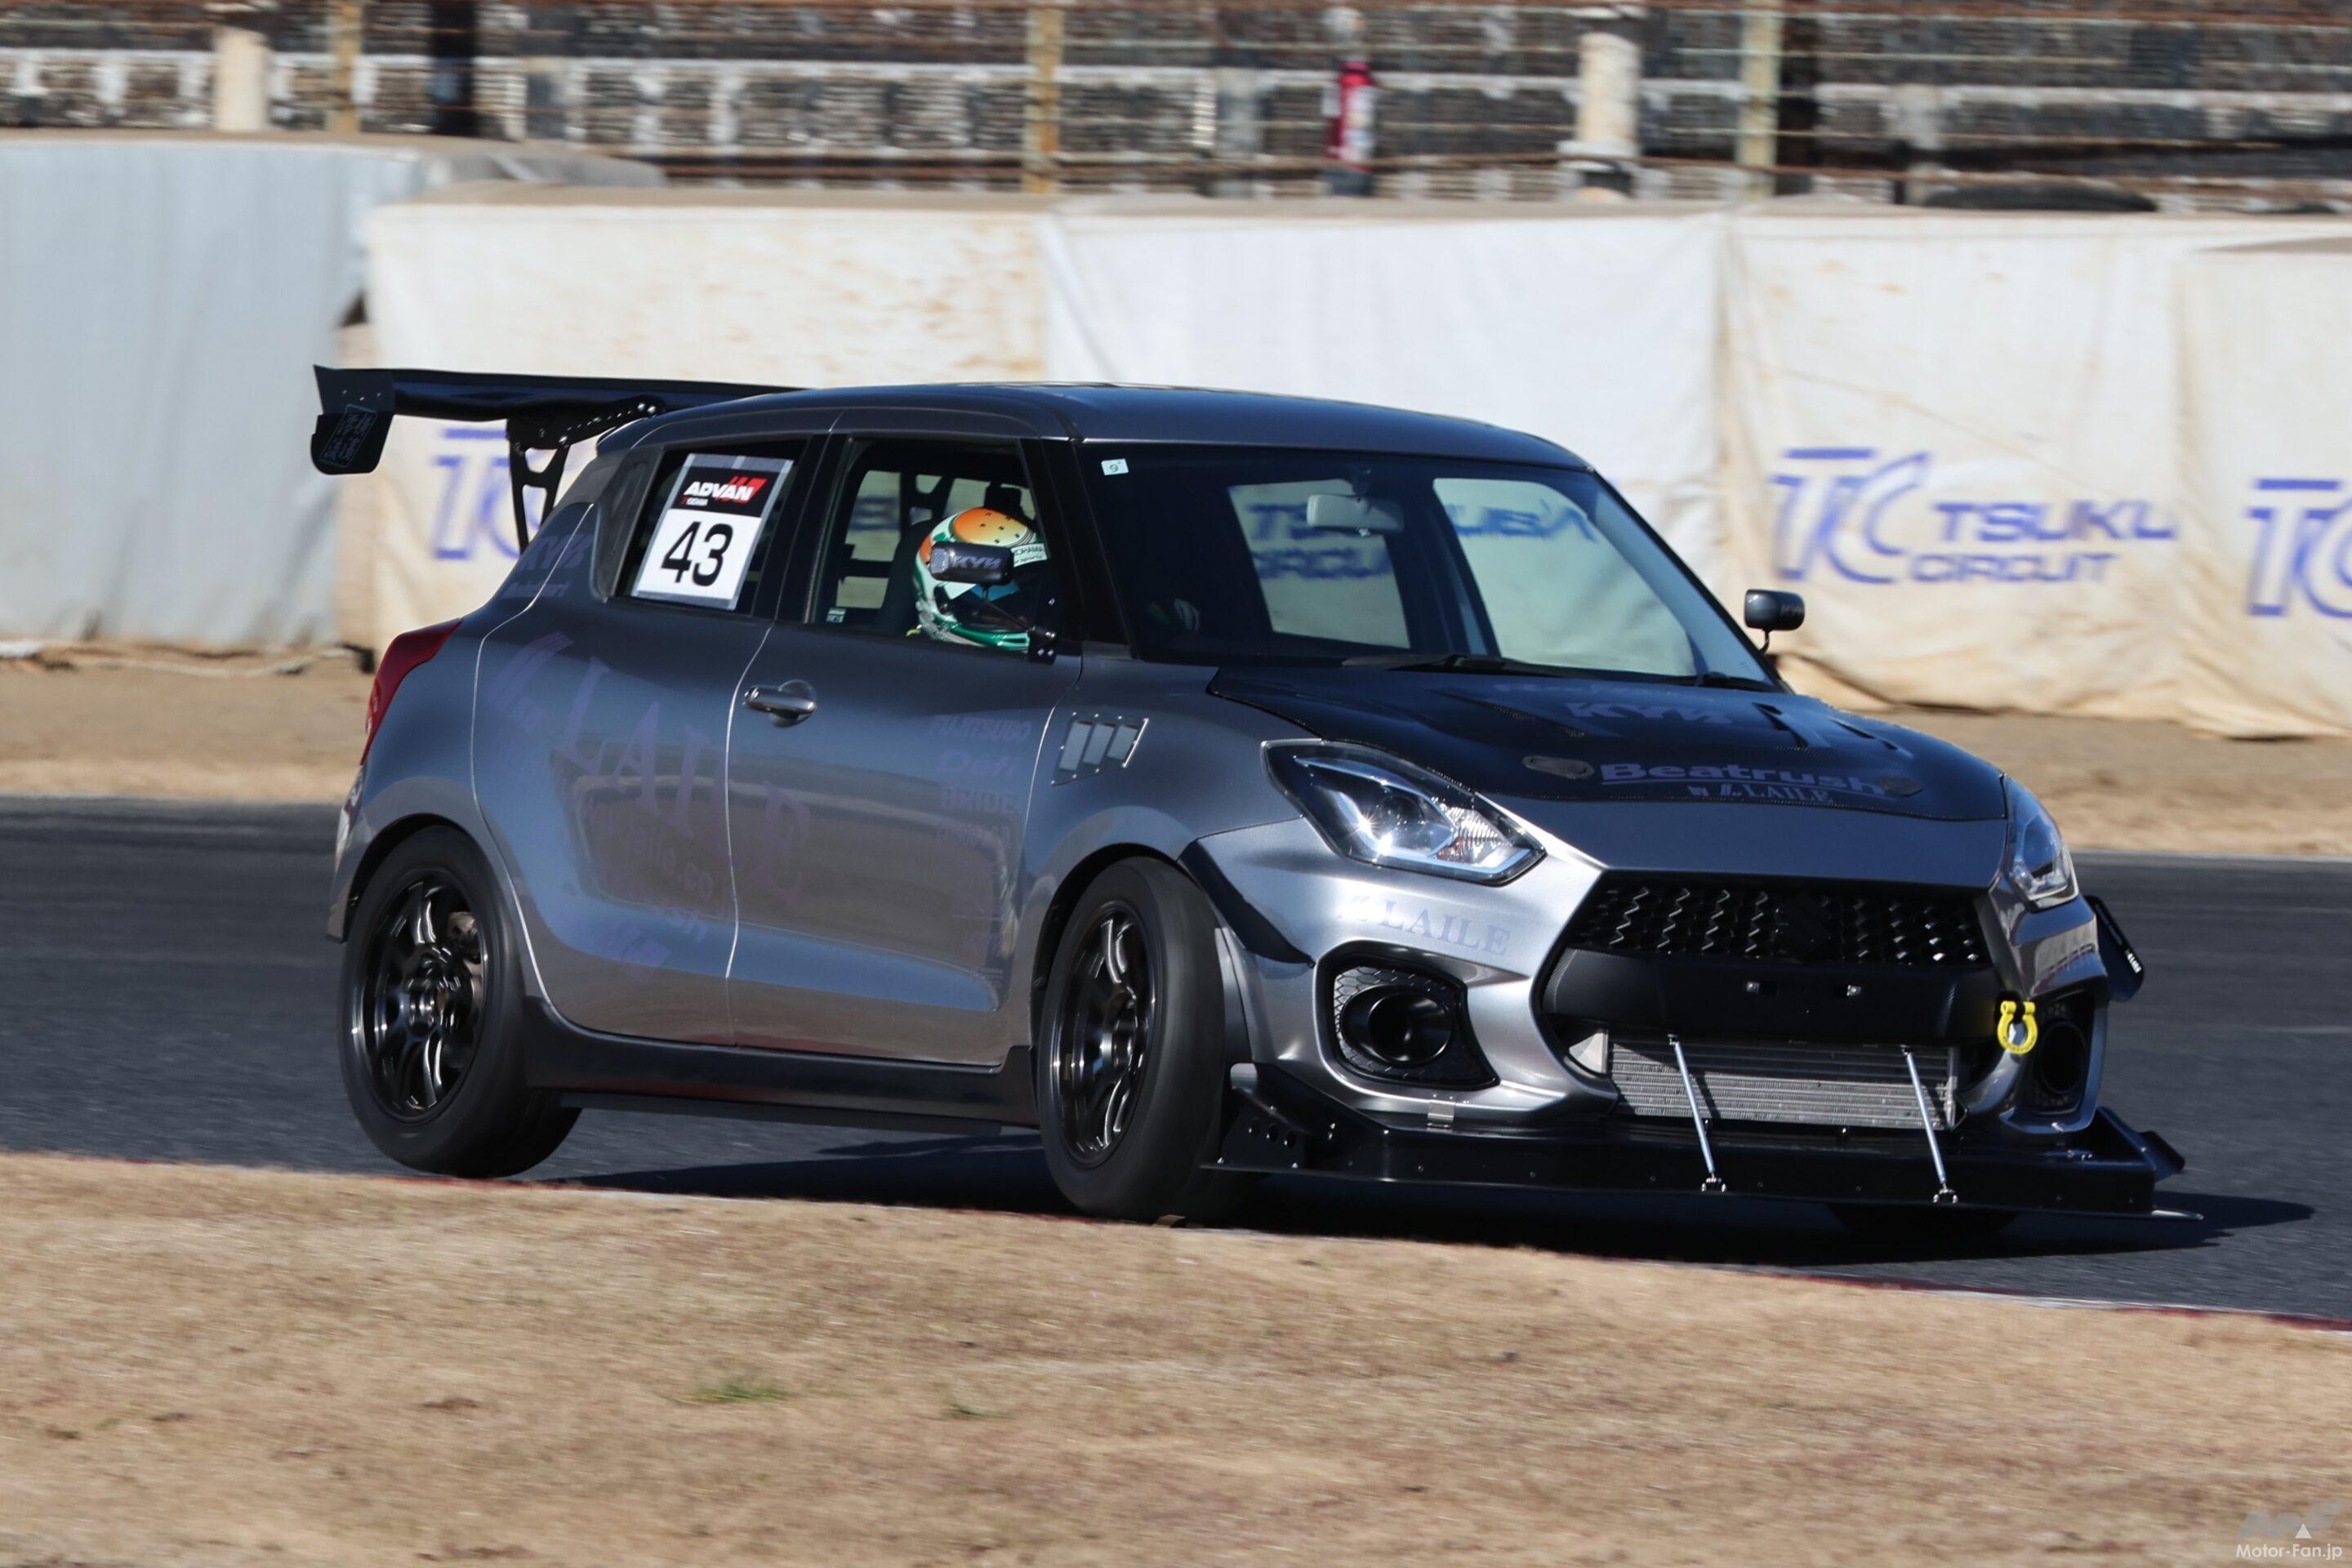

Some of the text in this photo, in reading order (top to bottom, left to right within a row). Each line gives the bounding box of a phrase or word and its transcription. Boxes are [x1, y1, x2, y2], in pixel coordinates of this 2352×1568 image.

[684, 481, 755, 501] ADVAN
[661, 521, 733, 587] 43
[1600, 763, 1885, 795] Beatrush
[1379, 900, 1512, 956] LAILE
